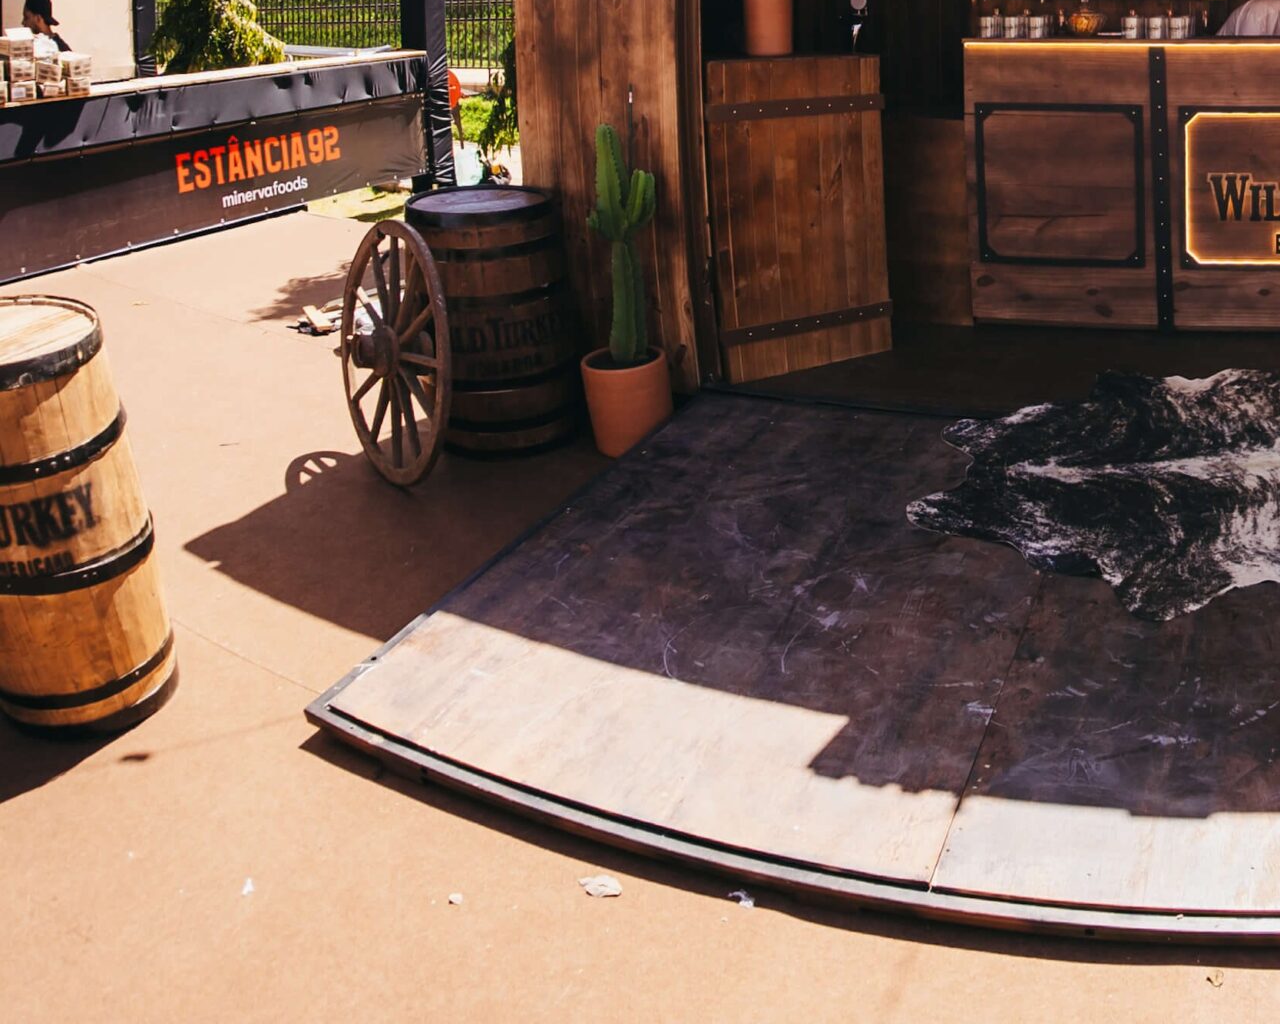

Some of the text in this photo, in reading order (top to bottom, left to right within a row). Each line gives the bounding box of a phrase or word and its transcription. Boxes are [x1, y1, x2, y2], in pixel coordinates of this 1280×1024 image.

[175, 125, 341, 193] ESTÂNCIA 92
[222, 175, 308, 208] minervafoods
